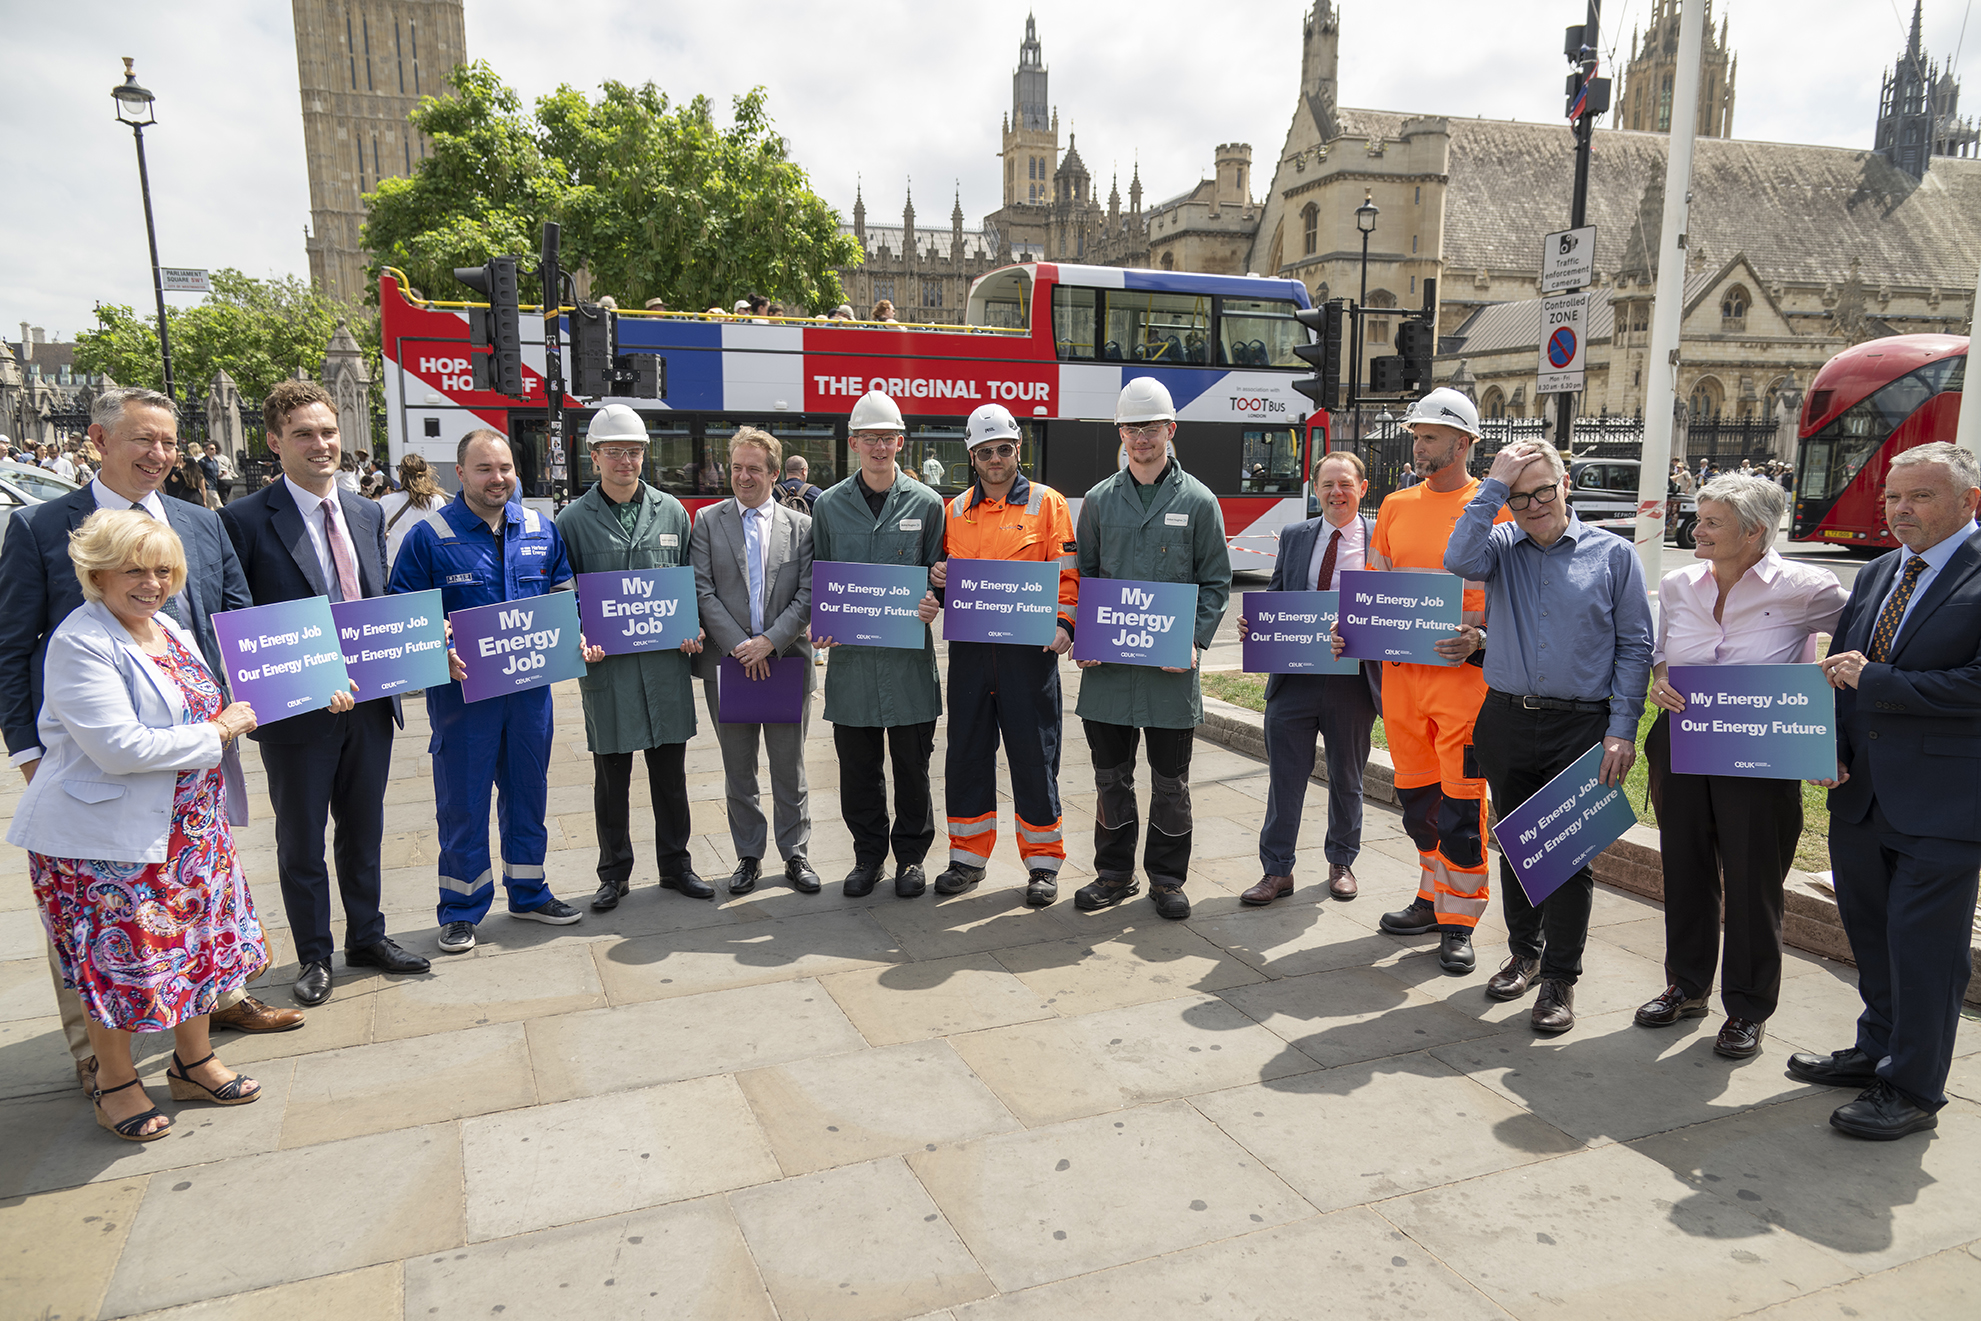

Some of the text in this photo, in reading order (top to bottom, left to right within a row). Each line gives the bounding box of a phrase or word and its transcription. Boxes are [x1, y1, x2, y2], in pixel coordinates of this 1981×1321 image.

[1556, 257, 1579, 268] Traffic
[1545, 266, 1589, 280] enforcement
[1552, 278, 1581, 288] cameras
[1544, 297, 1585, 311] Controlled
[1550, 310, 1578, 324] ZONE
[814, 376, 1050, 400] THE ORIGINAL TOUR
[622, 577, 654, 598] My
[828, 582, 910, 597] My Energy Job
[961, 579, 1042, 594] My Energy Job
[1121, 587, 1154, 608] My
[1356, 593, 1444, 608] My Energy Job
[602, 599, 678, 618] Energy
[820, 602, 919, 618] Our Energy Future
[952, 600, 1052, 614] Our Energy Future
[499, 609, 534, 630] My
[1096, 606, 1175, 632] Energy
[1259, 612, 1276, 623] My
[1278, 612, 1317, 624] Energy
[1347, 615, 1455, 630] Our Energy Future
[342, 616, 428, 641] My Energy Job
[622, 619, 663, 636] Job
[238, 625, 322, 654] My Energy Job
[478, 627, 560, 657] Energy
[1112, 629, 1154, 649] Job
[1251, 633, 1271, 642] Our
[1273, 633, 1313, 644] Energy
[362, 645, 402, 661] Energy
[405, 638, 442, 654] Future
[238, 651, 338, 683] Our Energy Future
[502, 651, 546, 675] Job
[1690, 693, 1809, 708] My Energy Job
[1681, 719, 1827, 736] Our Energy Future
[1519, 776, 1598, 845] My Energy Job
[1522, 788, 1618, 870] Our Energy Future
